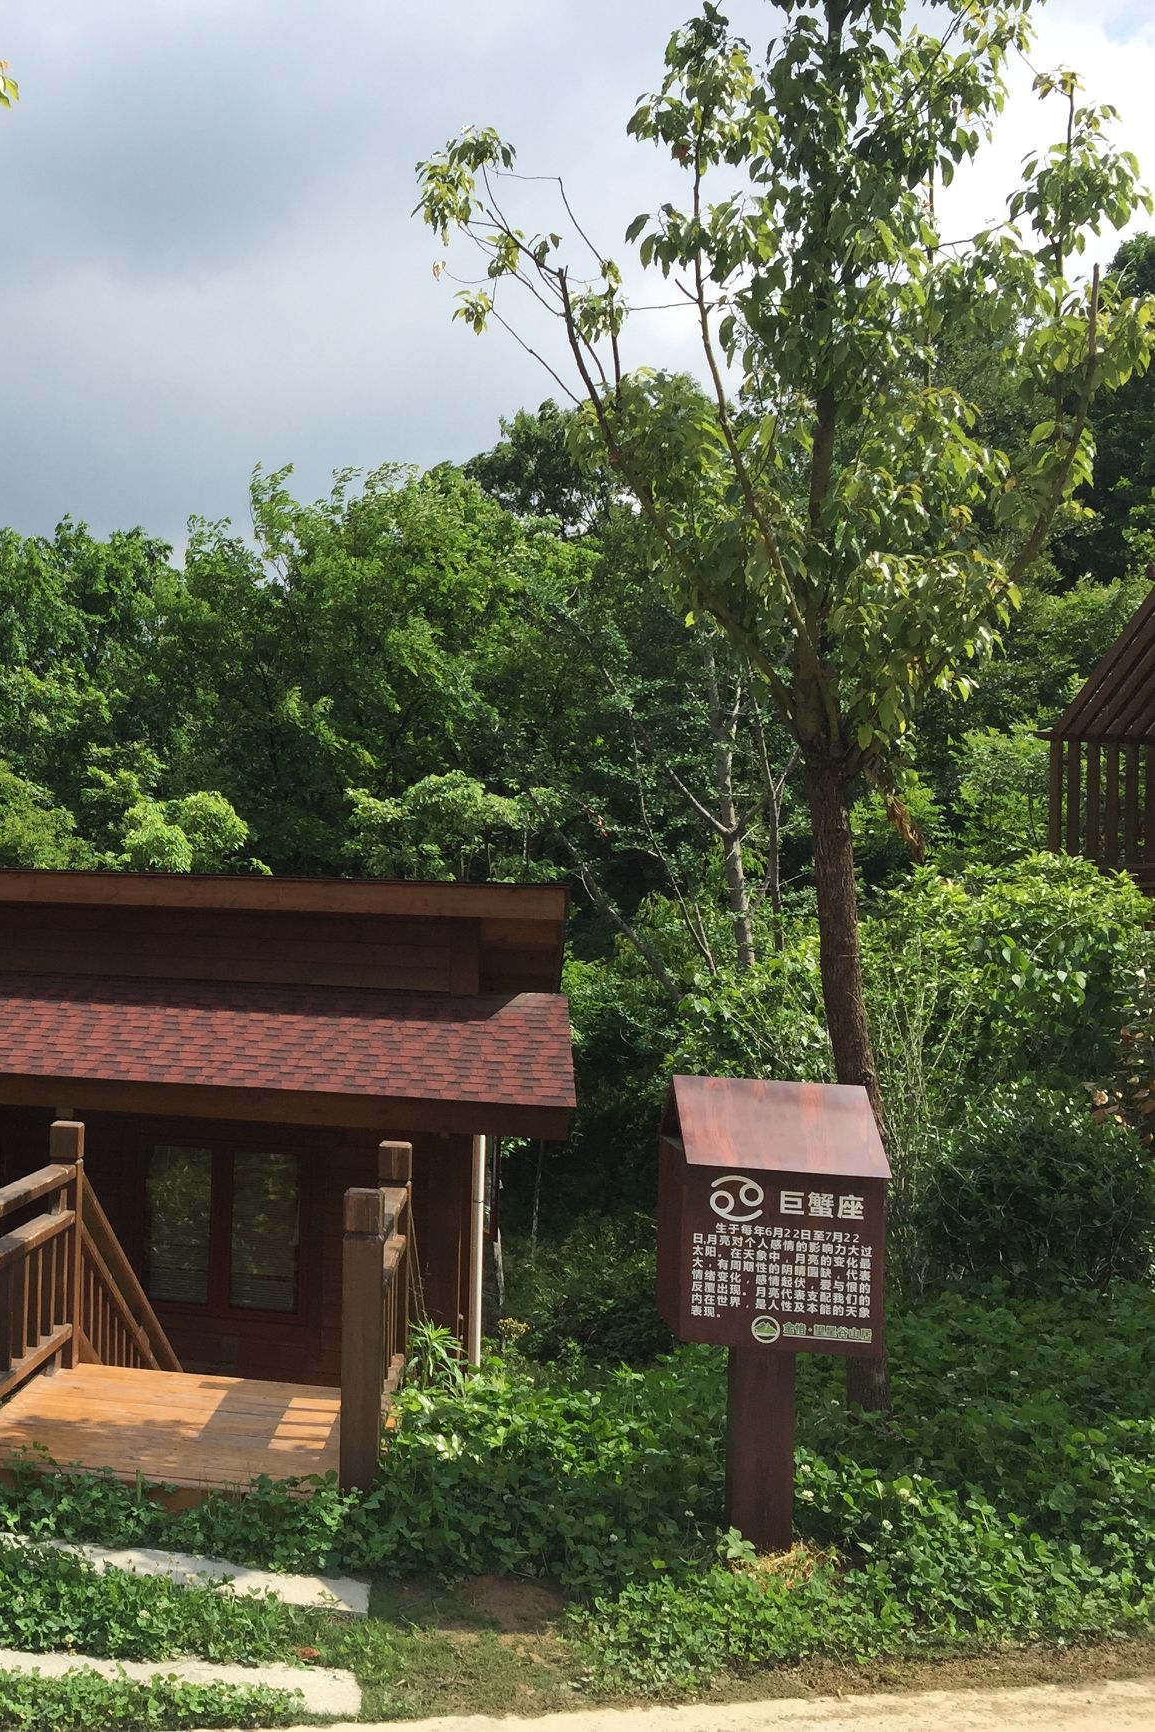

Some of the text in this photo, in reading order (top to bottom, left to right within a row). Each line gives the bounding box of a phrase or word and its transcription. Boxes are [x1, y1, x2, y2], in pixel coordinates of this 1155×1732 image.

[780, 1190, 864, 1220] 巨蟹座
[690, 1306, 721, 1318] 表现。
